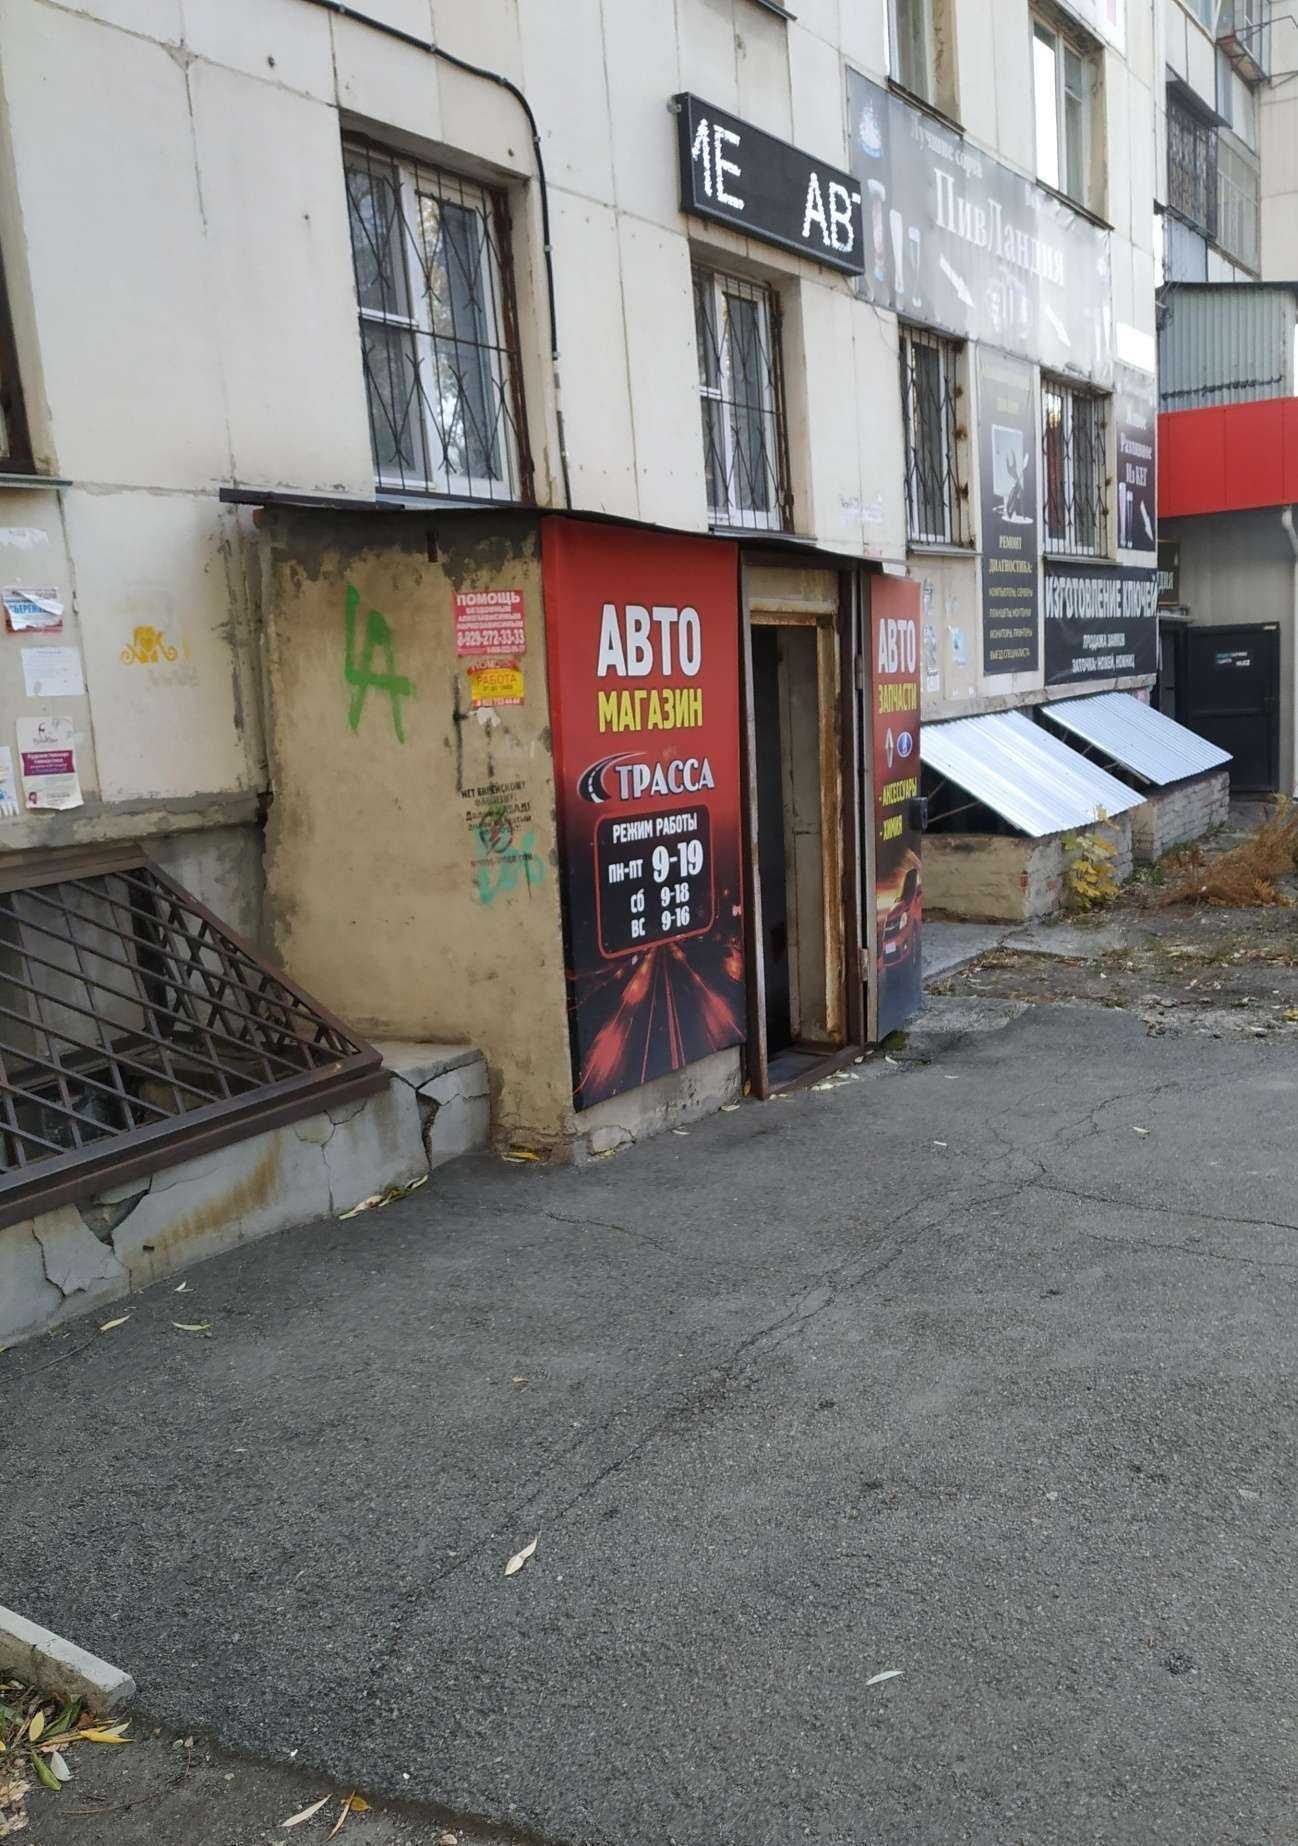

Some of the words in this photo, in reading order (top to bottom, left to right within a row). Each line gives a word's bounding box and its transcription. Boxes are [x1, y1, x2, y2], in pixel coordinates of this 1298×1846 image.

[999, 535, 1022, 550] РЕМОНТ
[456, 591, 521, 607] ПОМОЩЬ
[1046, 576, 1121, 618] ИЗГОТОВЛЕНИЕ
[1122, 574, 1158, 617] КЛЮЧЕЙ
[597, 604, 702, 677] АВТО
[878, 618, 916, 674] АВТО
[598, 688, 703, 733] МАГАЗИН
[878, 682, 917, 714] ЗАПЧАСТИ
[615, 757, 715, 801] ТРАССА
[612, 819, 653, 844] РЕЖИМ
[656, 812, 698, 837] РАБОТЫ
[652, 839, 704, 883] 9-19
[661, 882, 690, 907] 9-18
[661, 905, 690, 931] 9-16
